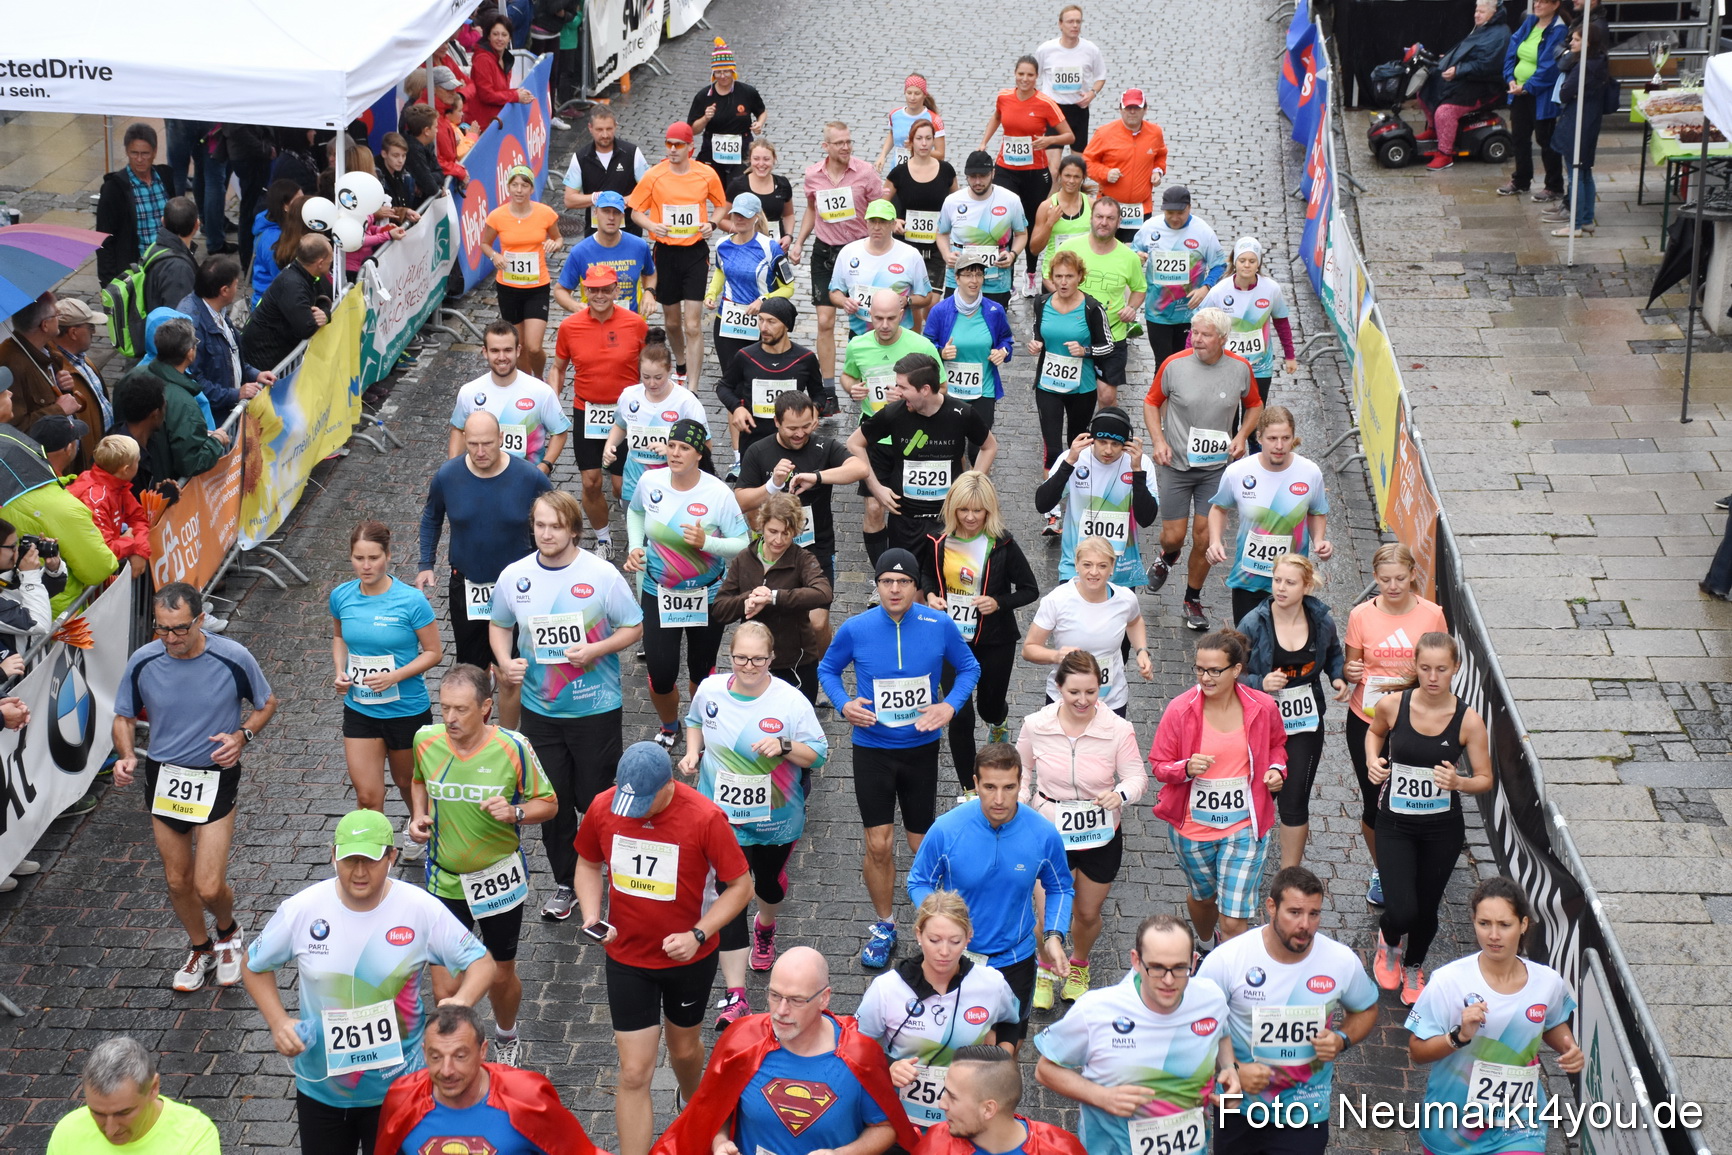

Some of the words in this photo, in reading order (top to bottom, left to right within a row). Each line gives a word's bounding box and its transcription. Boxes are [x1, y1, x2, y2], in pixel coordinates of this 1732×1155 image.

[1055, 72, 1080, 84] 3065
[9, 83, 51, 98] sein.
[715, 141, 739, 152] 2453
[1006, 143, 1030, 155] 2483
[825, 196, 847, 210] 132
[1121, 207, 1140, 218] 626
[462, 196, 487, 256] Hervis
[671, 213, 693, 226] 140
[912, 218, 934, 231] 336
[510, 260, 531, 273] 131
[1156, 259, 1187, 272] 2225
[725, 310, 758, 327] 2365
[733, 327, 747, 335] Petra
[1230, 338, 1261, 354] 2449
[1045, 361, 1078, 380] 2362
[948, 370, 980, 386] 2476
[1052, 379, 1066, 389] Anita
[590, 409, 615, 425] 225
[1192, 438, 1228, 454] 3084
[908, 470, 947, 486] 2529
[1084, 520, 1124, 539] 3004
[574, 586, 592, 595] Hervis
[663, 595, 703, 611] 3047
[667, 614, 692, 623] Annett
[536, 625, 581, 645] 2560
[1373, 646, 1415, 659] adida
[572, 680, 586, 689] 17.
[360, 689, 382, 698] Carina
[881, 688, 926, 709] 2582
[894, 711, 916, 721] Issam
[761, 720, 781, 731] Hervis
[1284, 720, 1306, 730] abrina
[168, 778, 204, 802] 291
[427, 778, 508, 804] BOCK
[720, 784, 766, 806] 2288
[1196, 789, 1245, 810] 2648
[1406, 800, 1434, 809] Kathrin
[172, 802, 194, 814] Klaus
[732, 808, 751, 818] Julia
[1062, 807, 1106, 831] 2091
[1211, 814, 1229, 824] Anja
[1070, 833, 1101, 843] Katarina
[632, 854, 658, 877] 17
[471, 866, 521, 902] 2894
[630, 879, 655, 892] Oliver
[487, 893, 516, 911] Helmut
[389, 931, 413, 942] Hervis
[308, 943, 330, 951] PARTL
[1310, 980, 1333, 991] Hervis
[1243, 990, 1266, 998] PARTL
[967, 1010, 987, 1020] Hervis
[1195, 1021, 1217, 1032] Hervis
[1260, 1021, 1319, 1044] 2465
[331, 1018, 392, 1051] 2619
[350, 1051, 378, 1064] Frank
[1280, 1049, 1296, 1058] Roi
[1476, 1077, 1534, 1104] 2470
[925, 1109, 942, 1120] Eva
[1140, 1124, 1200, 1155] 2542
